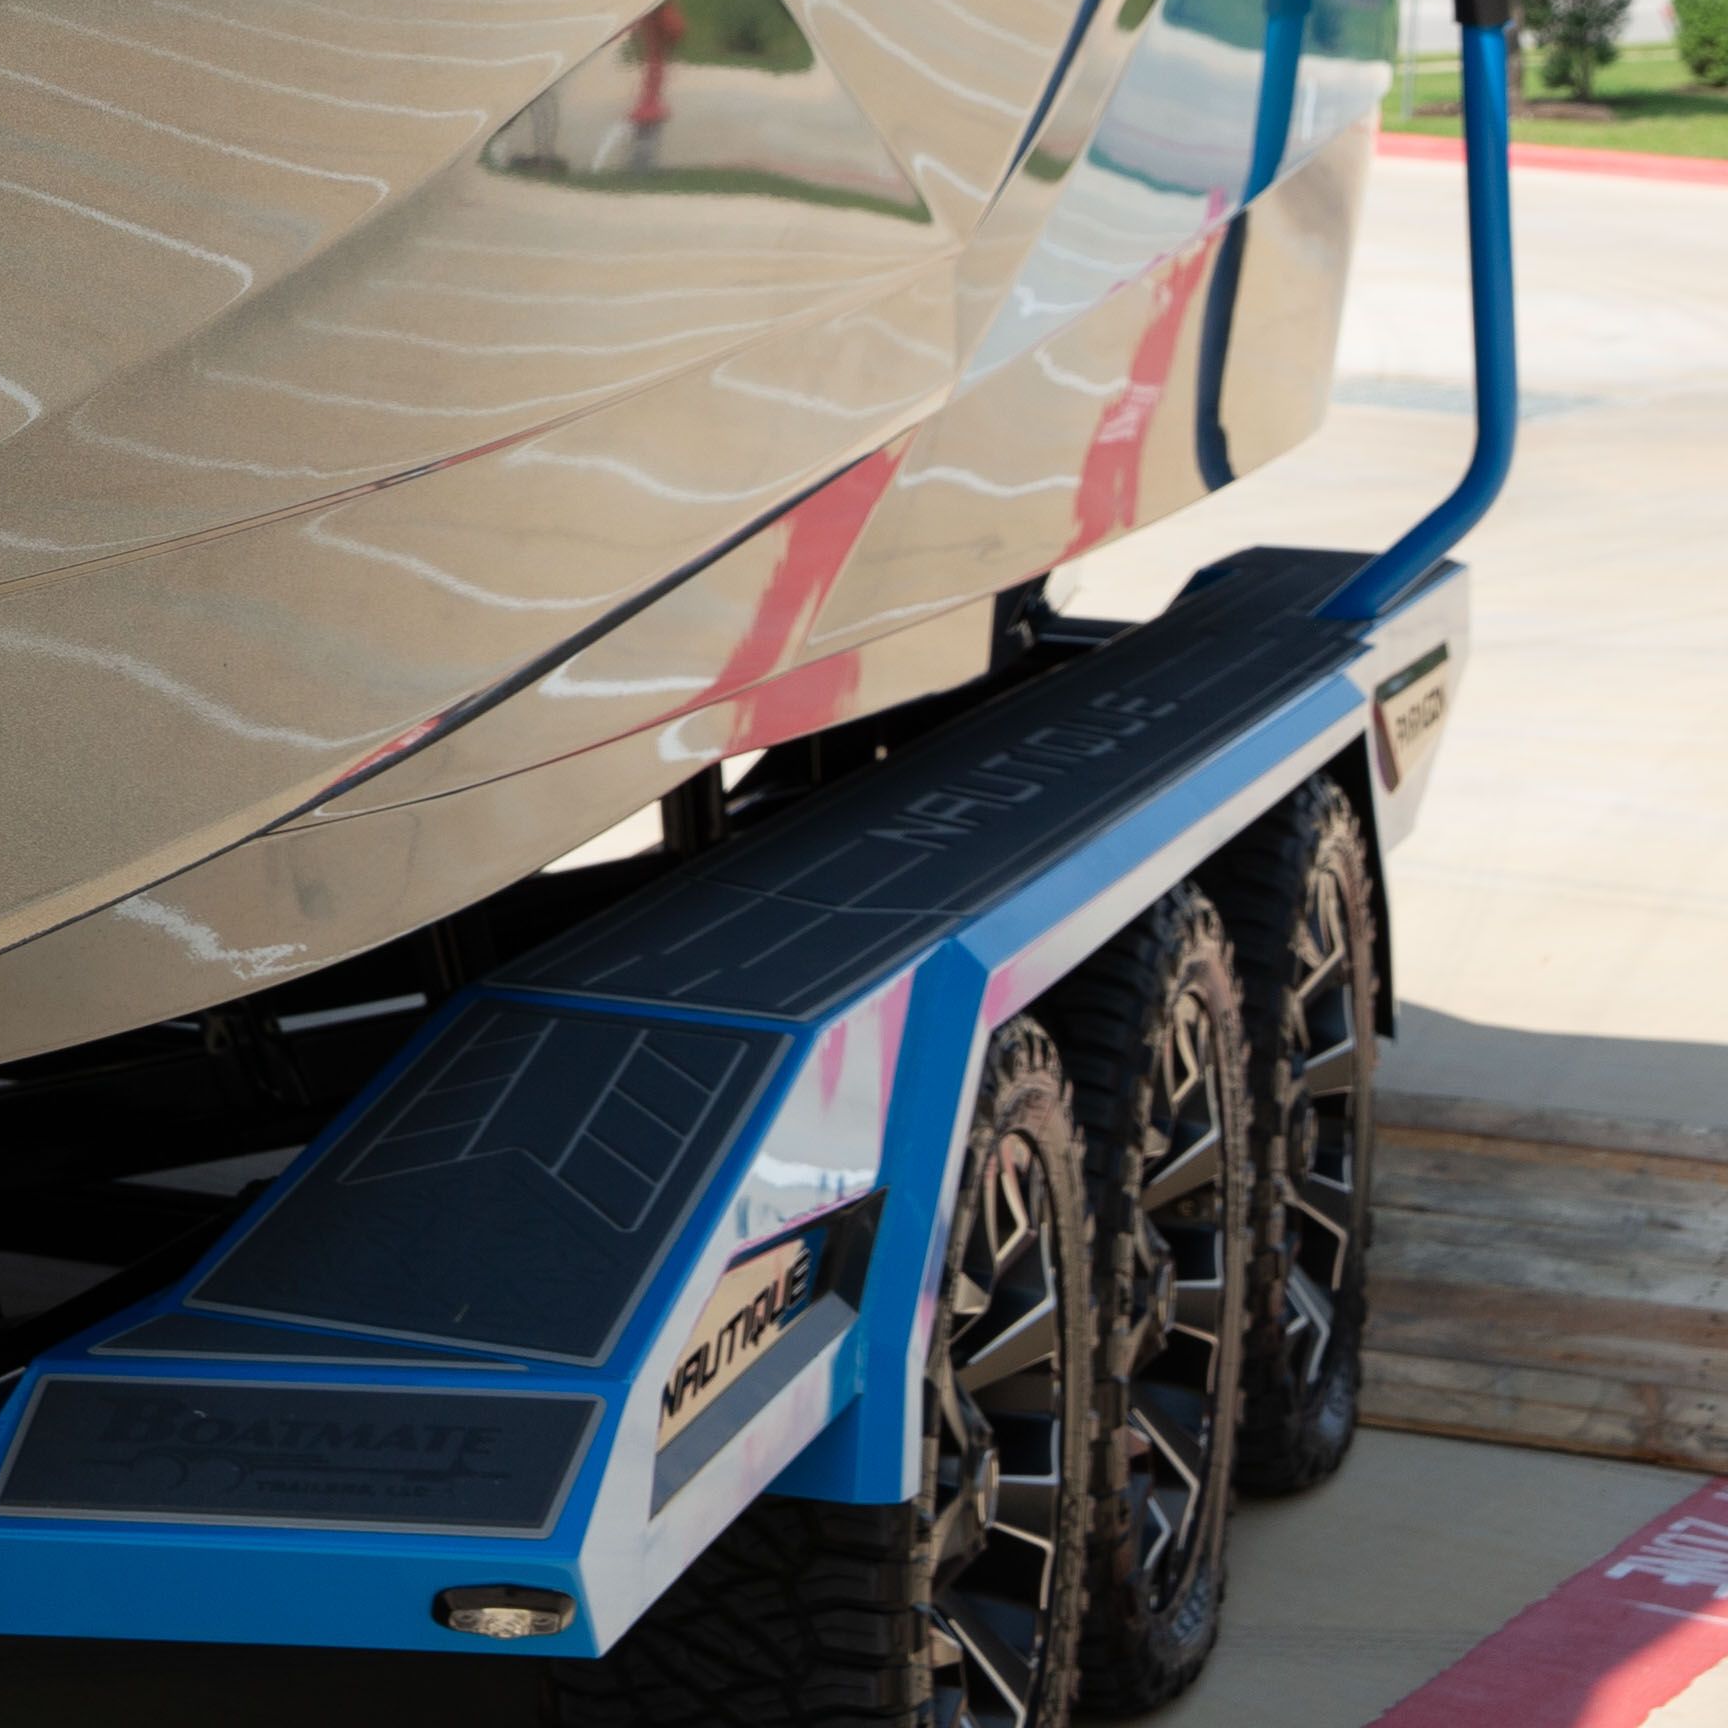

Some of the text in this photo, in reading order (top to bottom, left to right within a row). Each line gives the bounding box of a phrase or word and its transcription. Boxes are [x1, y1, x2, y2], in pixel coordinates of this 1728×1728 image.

[865, 689, 1180, 851] NAUTIQUE
[660, 1247, 812, 1418] NAUTIQUE
[95, 1393, 504, 1456] BOATMATE
